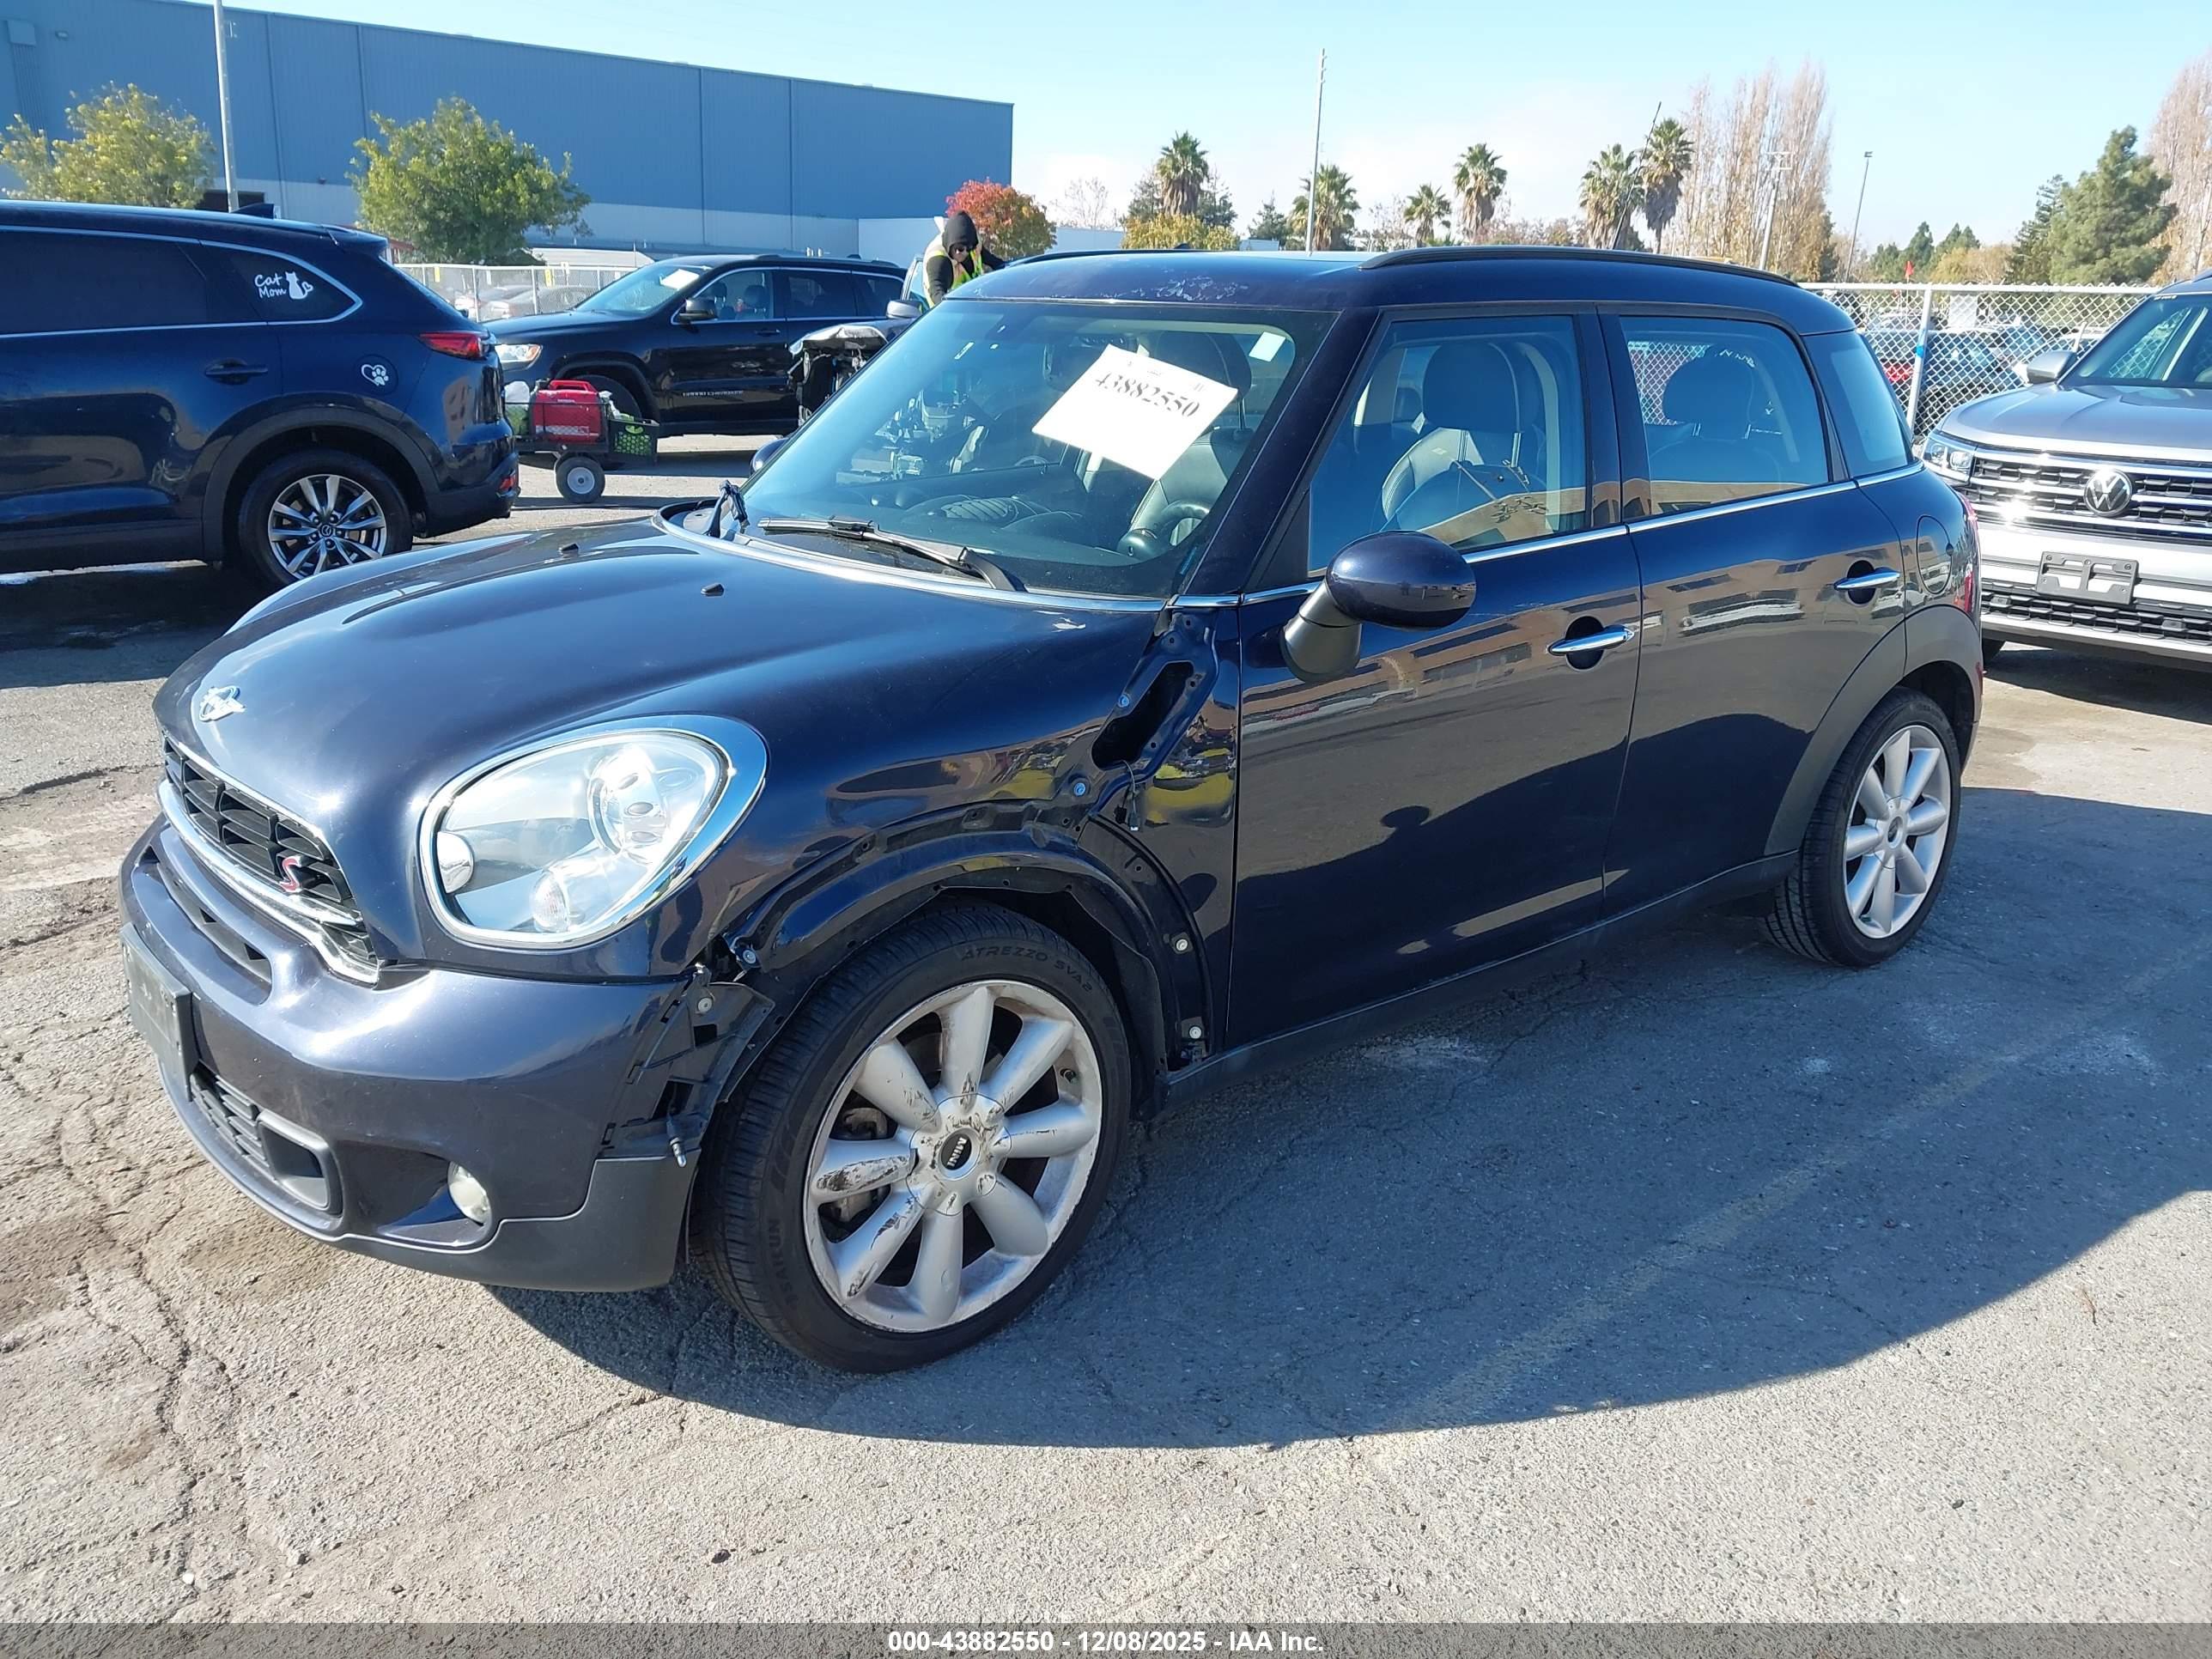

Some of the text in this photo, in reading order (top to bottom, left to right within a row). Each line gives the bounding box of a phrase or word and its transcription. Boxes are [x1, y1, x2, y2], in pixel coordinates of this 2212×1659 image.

[254, 273, 283, 287] Cat
[258, 286, 287, 299] Mom
[1095, 372, 1200, 417] 43882550
[279, 855, 302, 893] S
[961, 945, 1048, 962] ATREZZO
[946, 1137, 968, 1167] MINI
